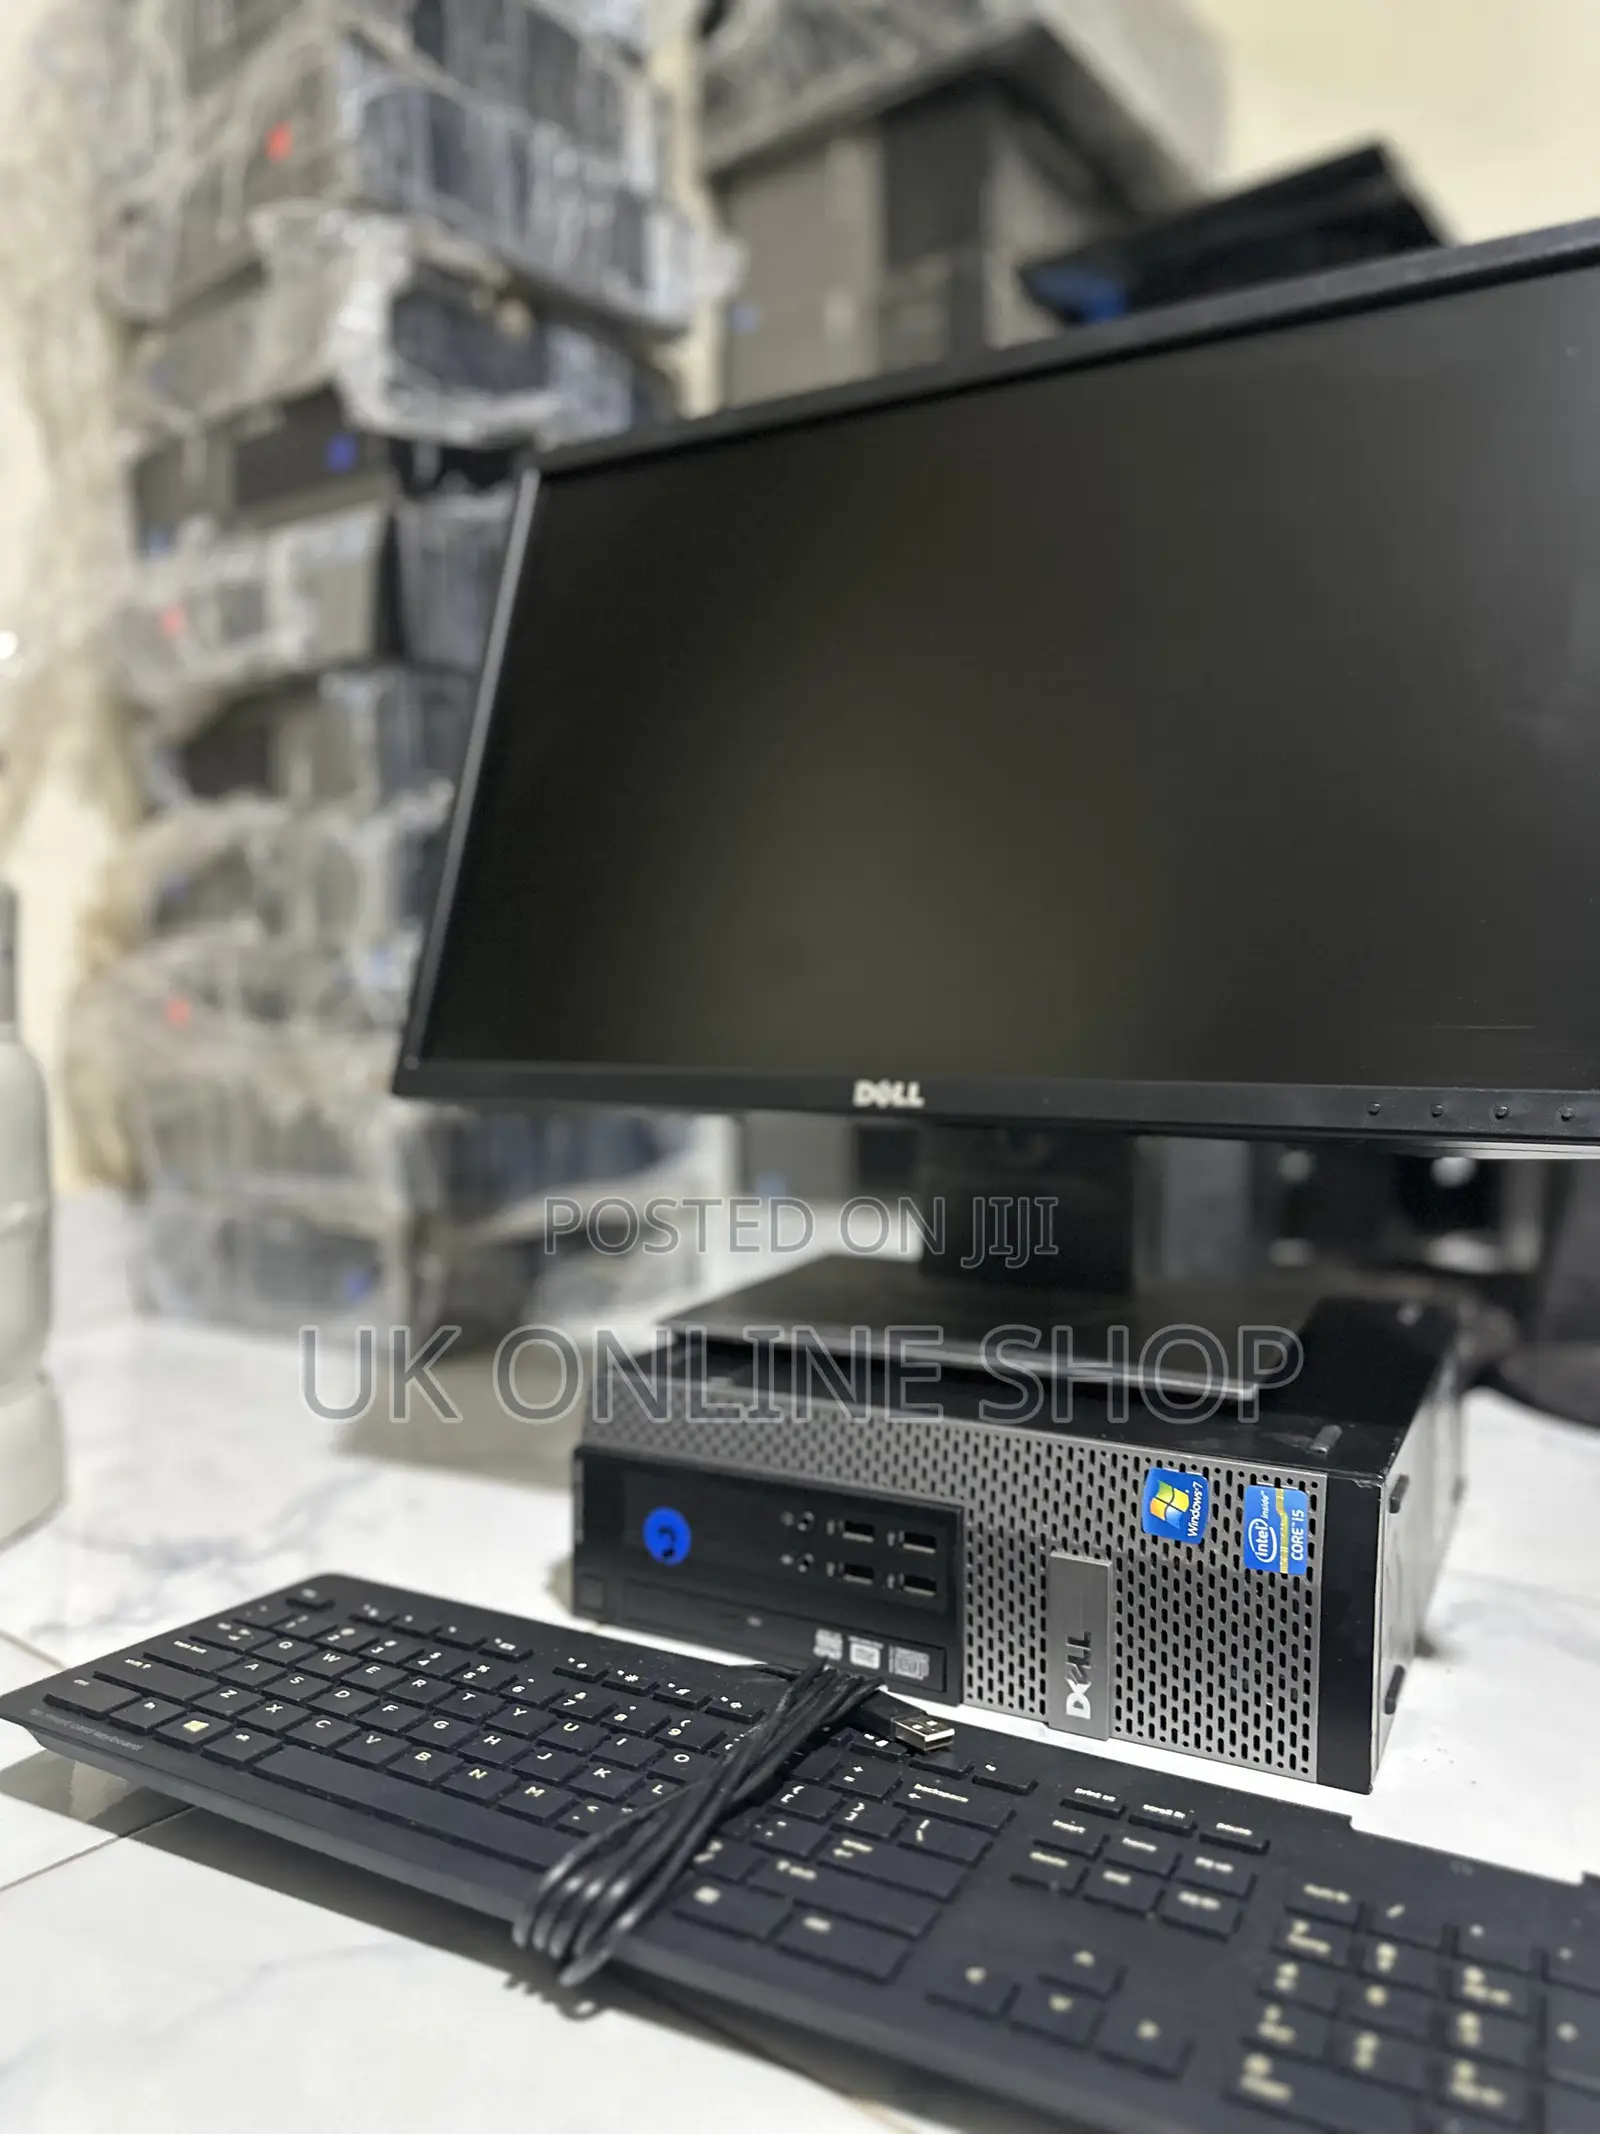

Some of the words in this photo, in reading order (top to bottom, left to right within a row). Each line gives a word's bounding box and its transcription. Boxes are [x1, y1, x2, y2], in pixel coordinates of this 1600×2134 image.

[852, 1078, 925, 1109] DELL
[1187, 1492, 1203, 1537] Windows
[278, 1641, 293, 1650] Q
[322, 1653, 341, 1663] W
[244, 1663, 259, 1671] A
[365, 1665, 381, 1674] E
[289, 1676, 305, 1684] S
[1065, 1631, 1092, 1720] DELL
[411, 1679, 427, 1688] R
[219, 1689, 238, 1699] Z
[334, 1690, 351, 1698] D
[462, 1692, 476, 1701] T
[265, 1703, 284, 1713] X
[381, 1704, 399, 1712] F
[513, 1707, 528, 1717] Y
[315, 1719, 332, 1729] C
[433, 1720, 450, 1730] G
[563, 1722, 580, 1732] U
[366, 1735, 382, 1744] V
[483, 1735, 502, 1746] H
[414, 1751, 432, 1762] B
[536, 1752, 553, 1760] J
[673, 1753, 690, 1763] O
[468, 1768, 488, 1780] N
[592, 1767, 612, 1779] K
[524, 1786, 545, 1798] M
[651, 1784, 664, 1795] L
